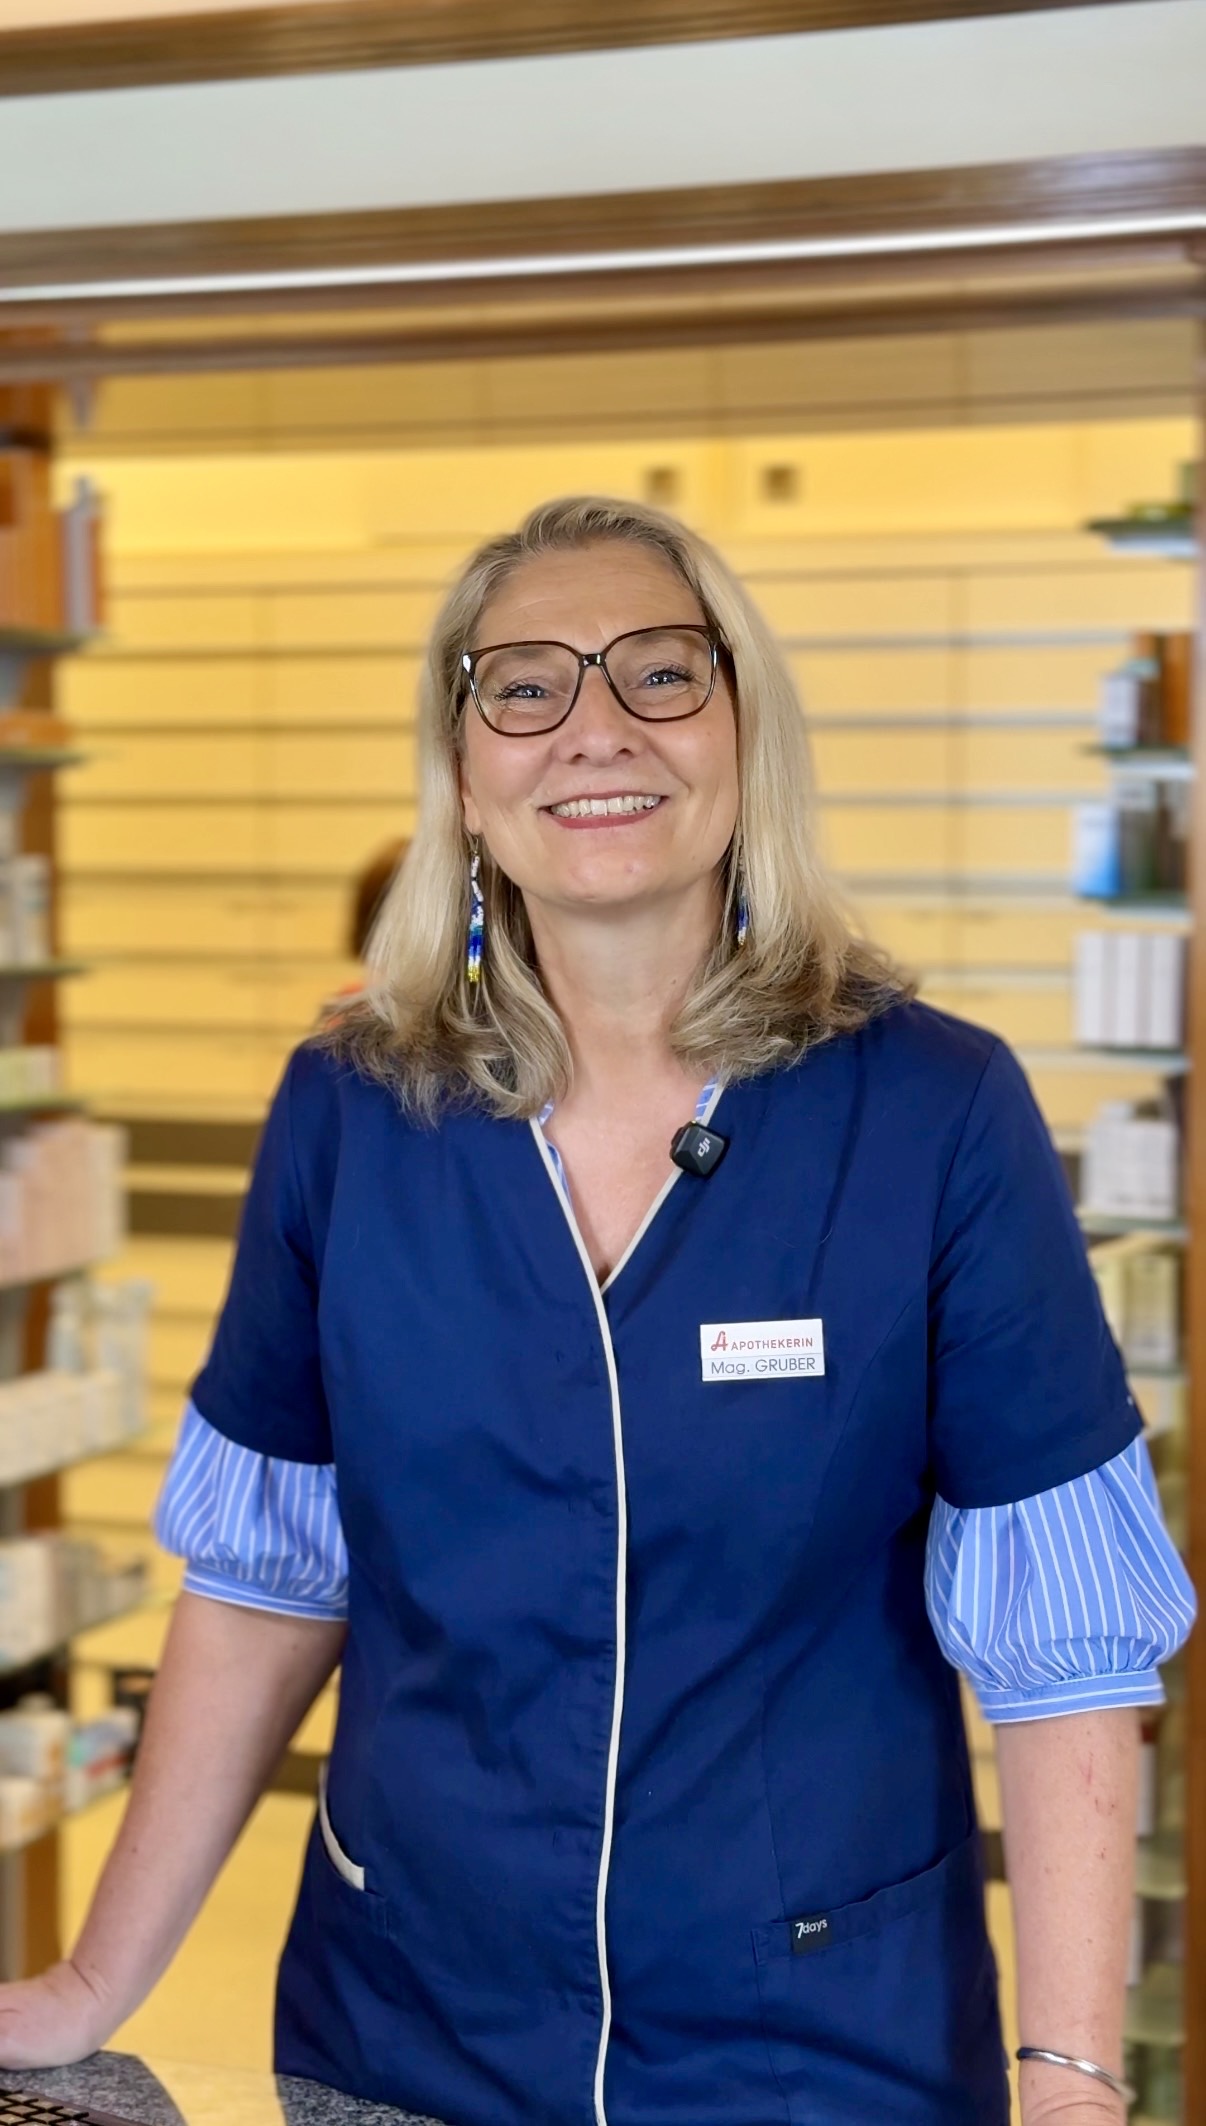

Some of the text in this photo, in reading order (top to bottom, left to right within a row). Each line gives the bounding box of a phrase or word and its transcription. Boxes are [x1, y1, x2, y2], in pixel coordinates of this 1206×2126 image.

[731, 1337, 813, 1351] APOTHEKERIN
[711, 1357, 816, 1375] Mag. GRUBER
[795, 1919, 828, 1939] 7days
